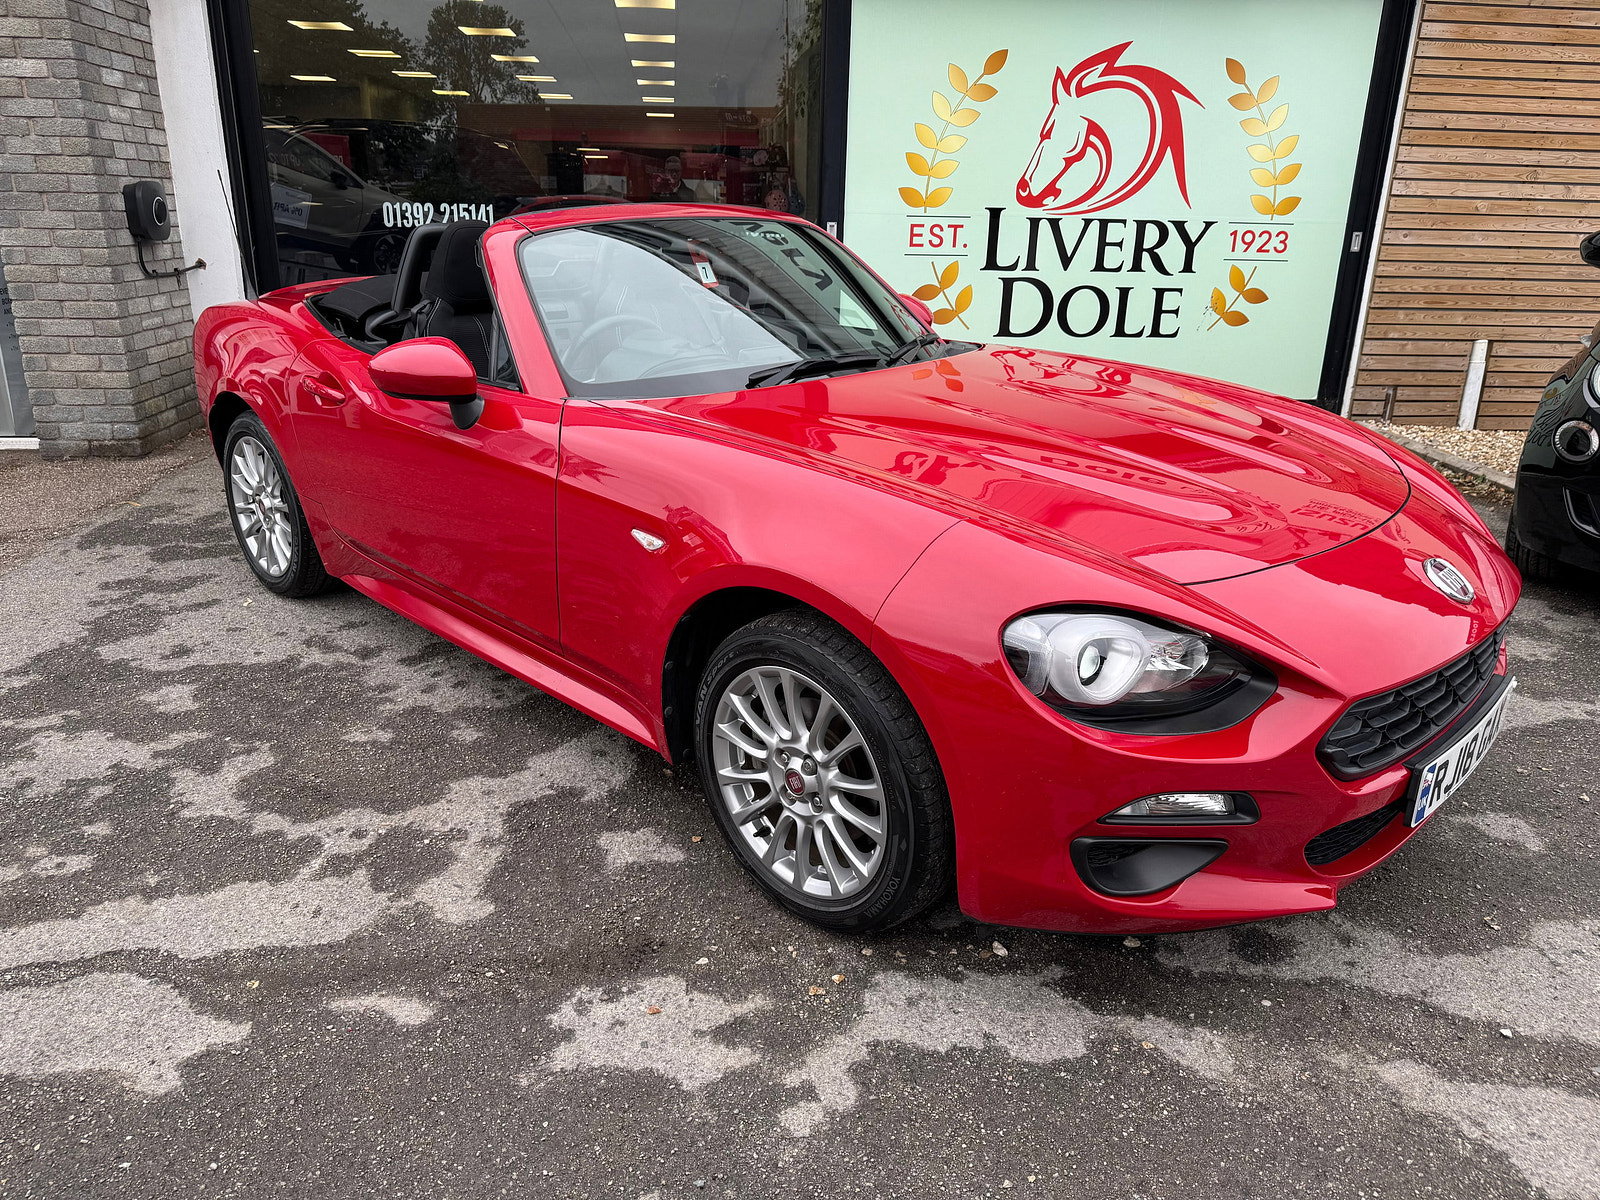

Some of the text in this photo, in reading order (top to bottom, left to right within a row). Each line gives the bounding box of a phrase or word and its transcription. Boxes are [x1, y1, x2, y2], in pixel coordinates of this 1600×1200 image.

[382, 201, 494, 228] 01392 215141
[909, 224, 968, 249] EST.
[980, 207, 1218, 276] LIVERY
[1229, 229, 1289, 254] 1923
[993, 276, 1183, 339] DOLE
[1429, 733, 1479, 807] RJ18
[864, 876, 901, 918] YOKOHAMA
